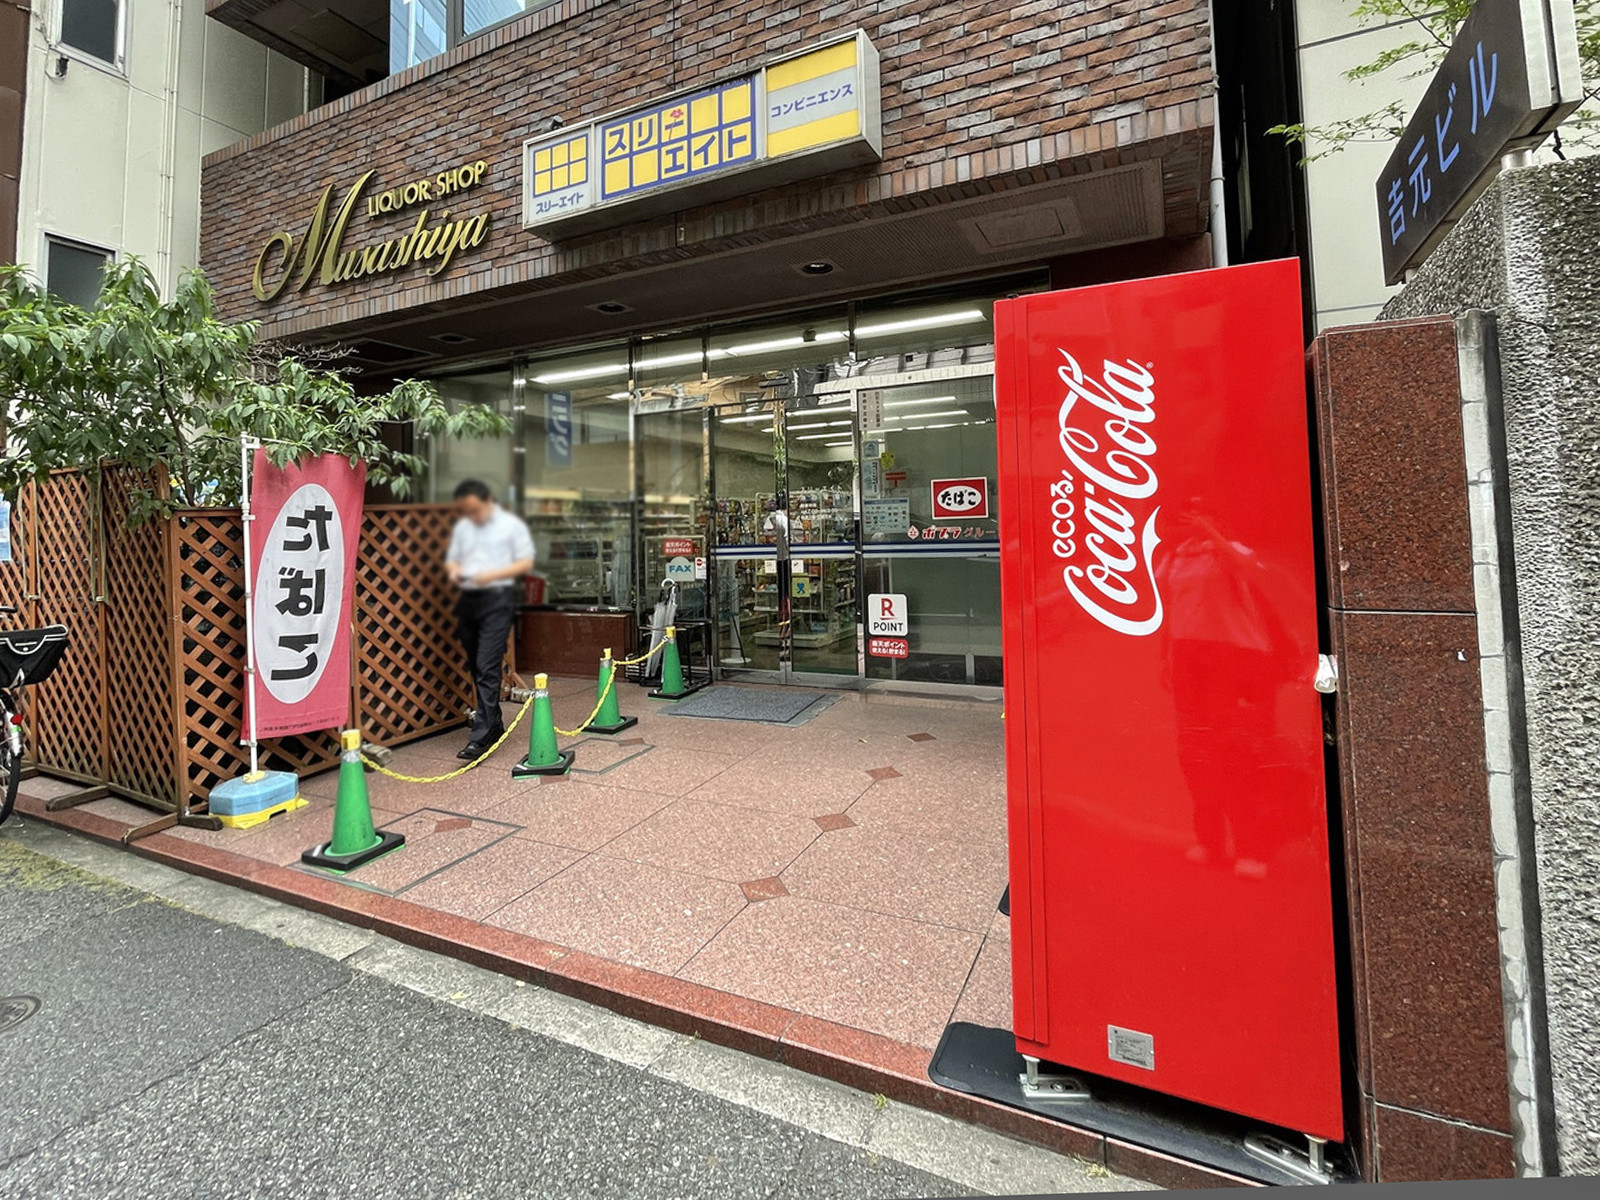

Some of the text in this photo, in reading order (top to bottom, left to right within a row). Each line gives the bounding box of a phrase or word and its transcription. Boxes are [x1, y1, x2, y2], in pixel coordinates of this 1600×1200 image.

[771, 84, 853, 118] コンビニエンス
[608, 118, 685, 156] スリー
[663, 130, 748, 175] エイト
[1387, 41, 1499, 246] 吉元ビル
[368, 160, 489, 218] LIQUOR SHOP
[535, 192, 584, 215] スリーエイト
[252, 169, 492, 302] Musashiya
[940, 488, 977, 507] たばこ
[1057, 347, 1164, 637] Coca-Cola
[921, 524, 996, 540] ポプラグルー
[669, 564, 691, 573] FAX
[880, 597, 895, 620] R
[873, 621, 904, 632] POINT
